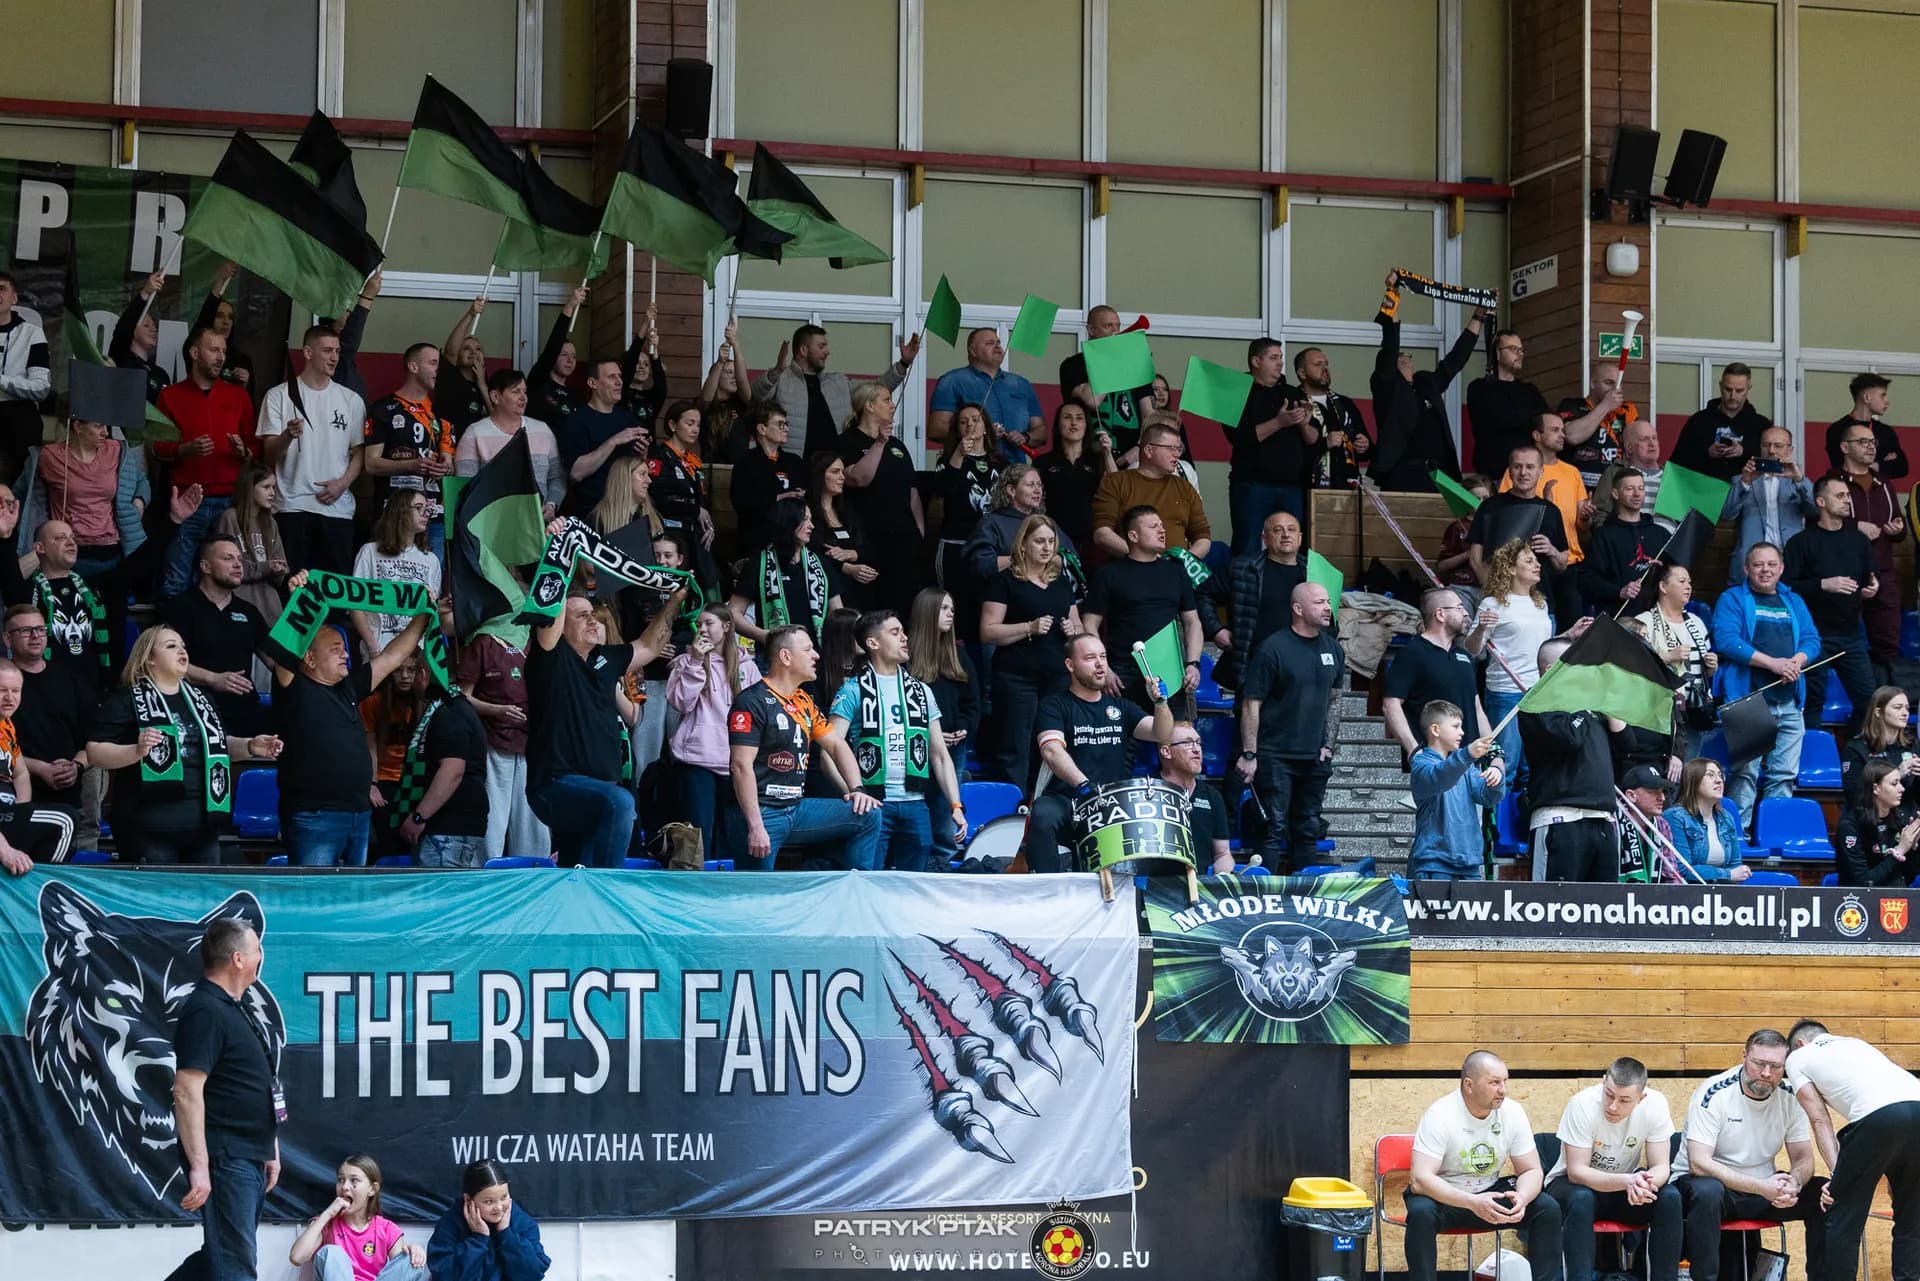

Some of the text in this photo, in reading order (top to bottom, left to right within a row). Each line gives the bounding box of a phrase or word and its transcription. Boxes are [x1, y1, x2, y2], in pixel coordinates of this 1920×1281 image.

[1512, 259, 1554, 281] SEKTOR
[1443, 288, 1480, 305] Centralna
[1512, 279, 1528, 298] G
[413, 422, 424, 443] 9
[890, 704, 904, 724] 9
[793, 723, 804, 748] 4
[1170, 894, 1395, 935] MŁODE WILKI
[1403, 889, 1821, 938] www.koronahandball.pl
[1883, 911, 1902, 929] CK
[304, 967, 866, 1098] THE BEST FANS
[452, 1132, 715, 1165] WILCZA WATAHA TEAM
[927, 1213, 968, 1226] HOTEL
[991, 1212, 1041, 1225] RESORT
